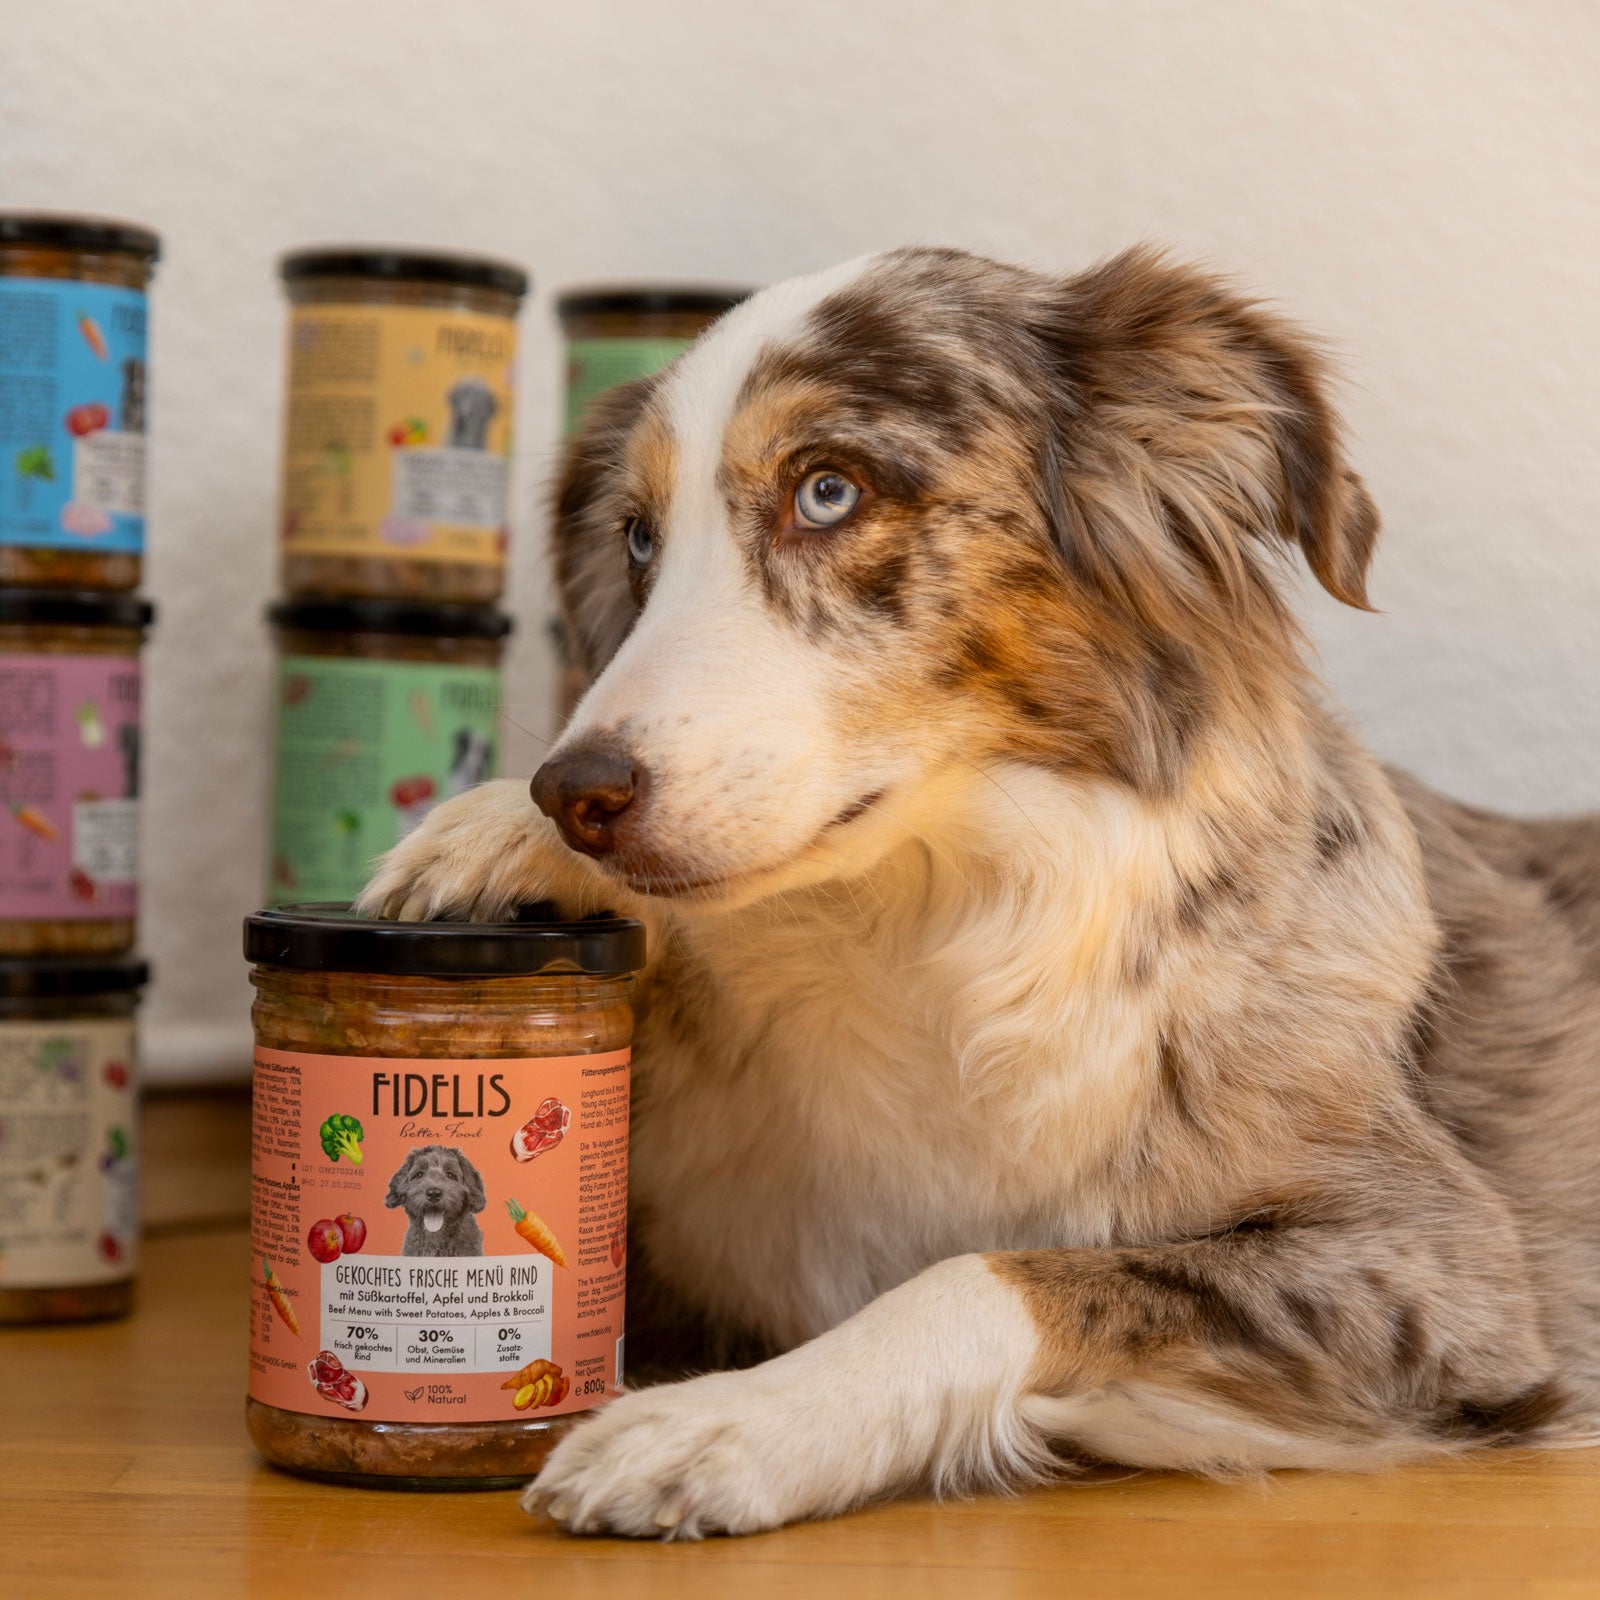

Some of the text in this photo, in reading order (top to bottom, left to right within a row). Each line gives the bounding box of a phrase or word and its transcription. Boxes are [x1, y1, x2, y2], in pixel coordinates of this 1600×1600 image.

[291, 1088, 301, 1096] und
[373, 1073, 511, 1117] FIDELIS
[399, 1121, 483, 1138] Better Food
[336, 1265, 538, 1288] GEKOCHTES FRISCHE MENÜ RIND
[339, 1289, 534, 1306] mit Süßkartoffel, Apfel und Brokkoli
[328, 1304, 545, 1320] Beef Menu with Sweet Potatoes, Apples & Broccoli
[346, 1326, 379, 1341] 70%
[418, 1329, 454, 1343] 30%
[497, 1328, 522, 1341] 0%
[334, 1340, 393, 1354] frisch gekochtes
[407, 1345, 465, 1355] Obst, Gemüse
[496, 1344, 524, 1353] Zusatz-
[354, 1352, 371, 1361] Rind
[405, 1355, 466, 1364] und Mineralien
[499, 1353, 520, 1362] stoffe
[427, 1384, 453, 1394] 100%
[584, 1379, 605, 1394] 800g
[427, 1394, 467, 1404] Natural
